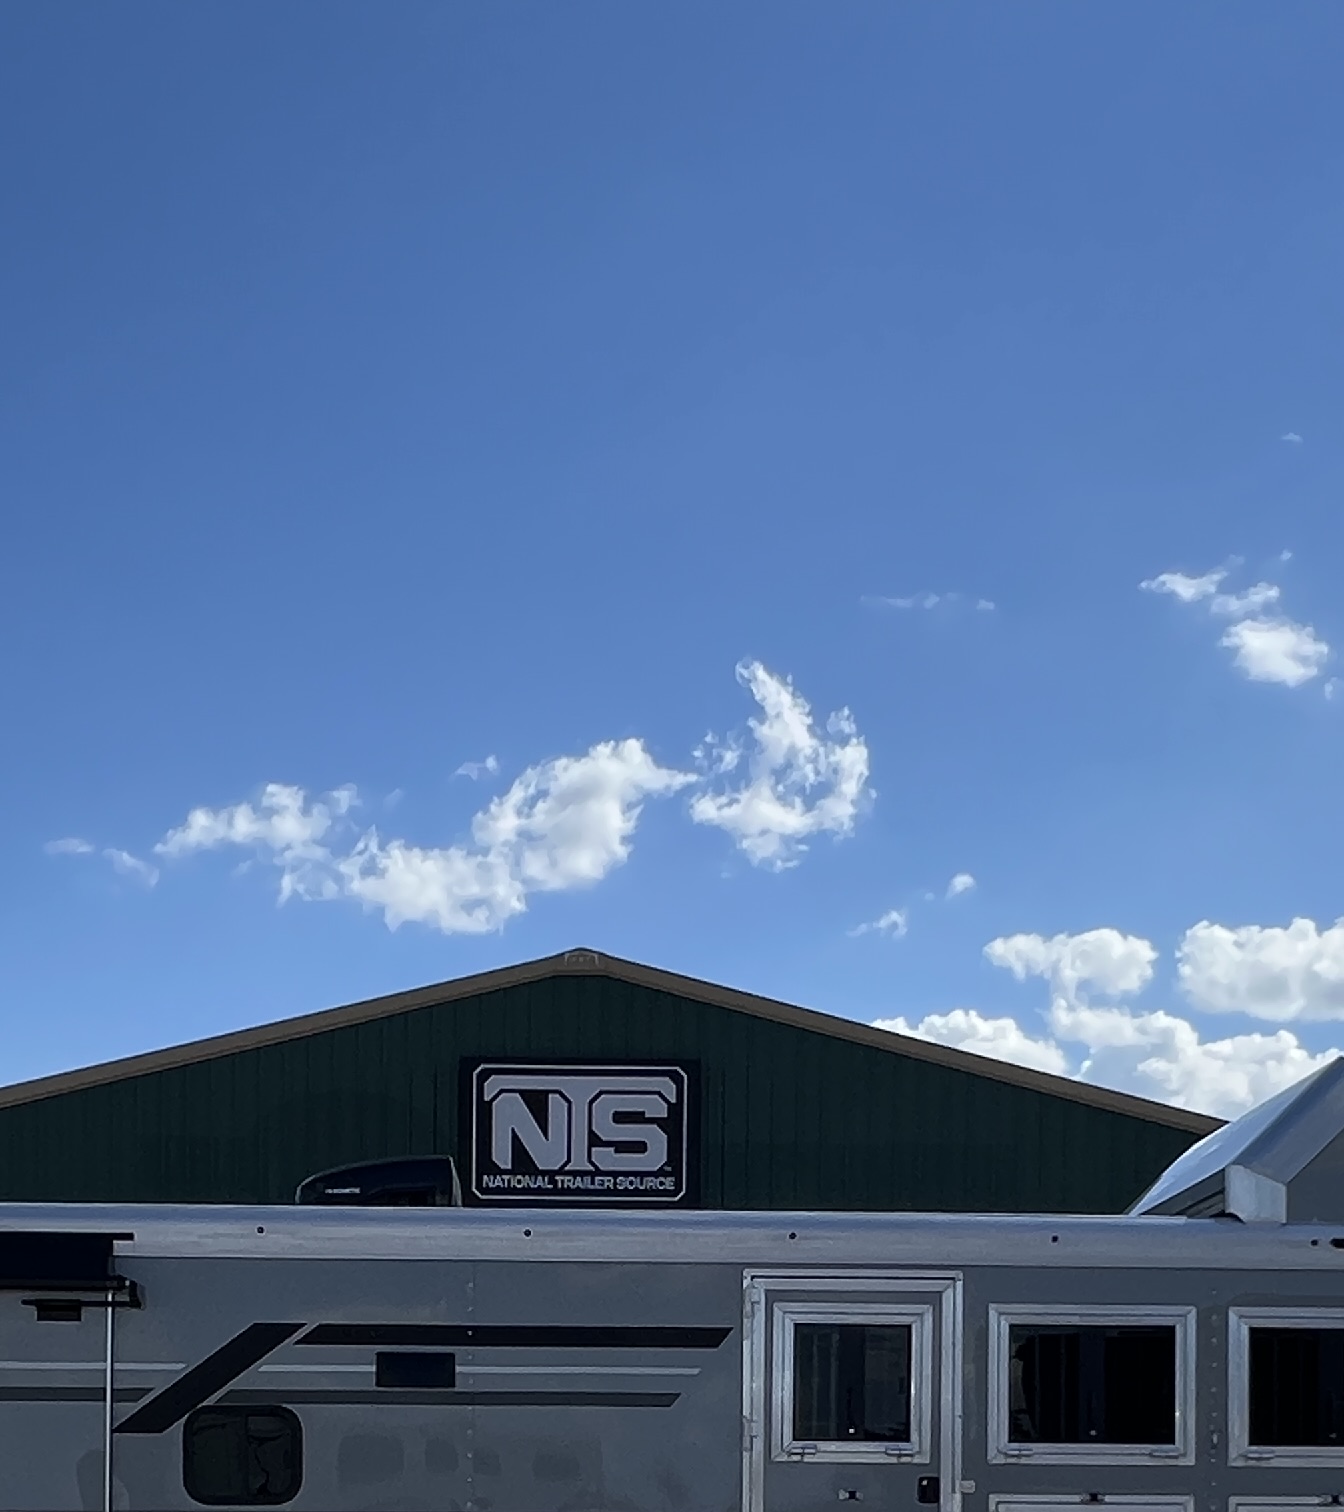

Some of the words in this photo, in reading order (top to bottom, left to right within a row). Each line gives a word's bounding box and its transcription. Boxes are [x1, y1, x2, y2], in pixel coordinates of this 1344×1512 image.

[483, 1074, 677, 1172] NTS
[482, 1174, 553, 1188] NATIONAL
[555, 1175, 615, 1190] TRAILER
[616, 1176, 675, 1191] SOURCE
